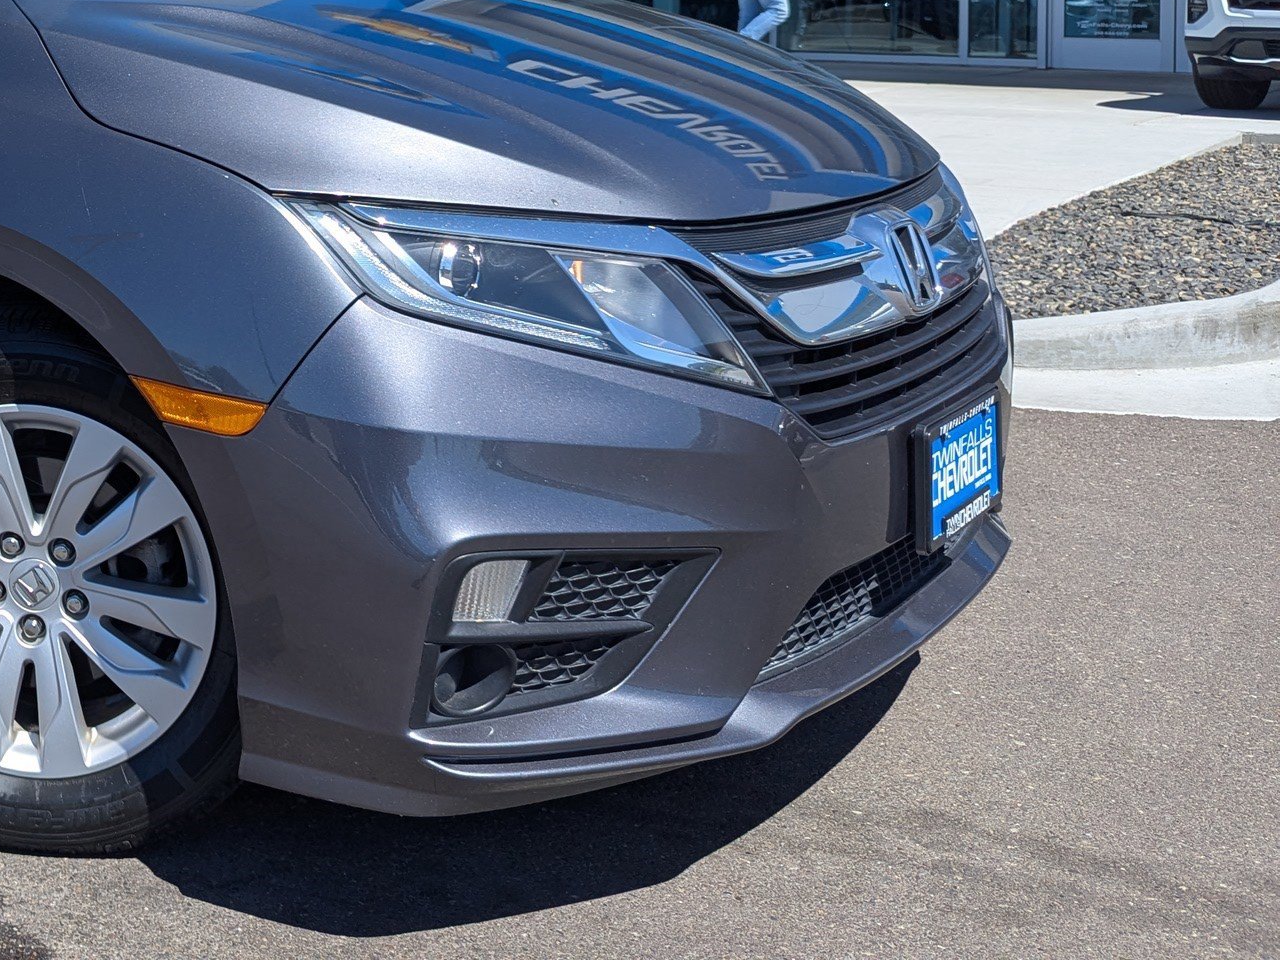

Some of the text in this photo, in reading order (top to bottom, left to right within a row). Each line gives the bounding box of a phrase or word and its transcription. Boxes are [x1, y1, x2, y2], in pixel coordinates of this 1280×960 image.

[931, 418, 993, 473] TWINFALLS
[931, 437, 993, 508] CHEVROLET
[959, 489, 991, 528] CHEVROLET
